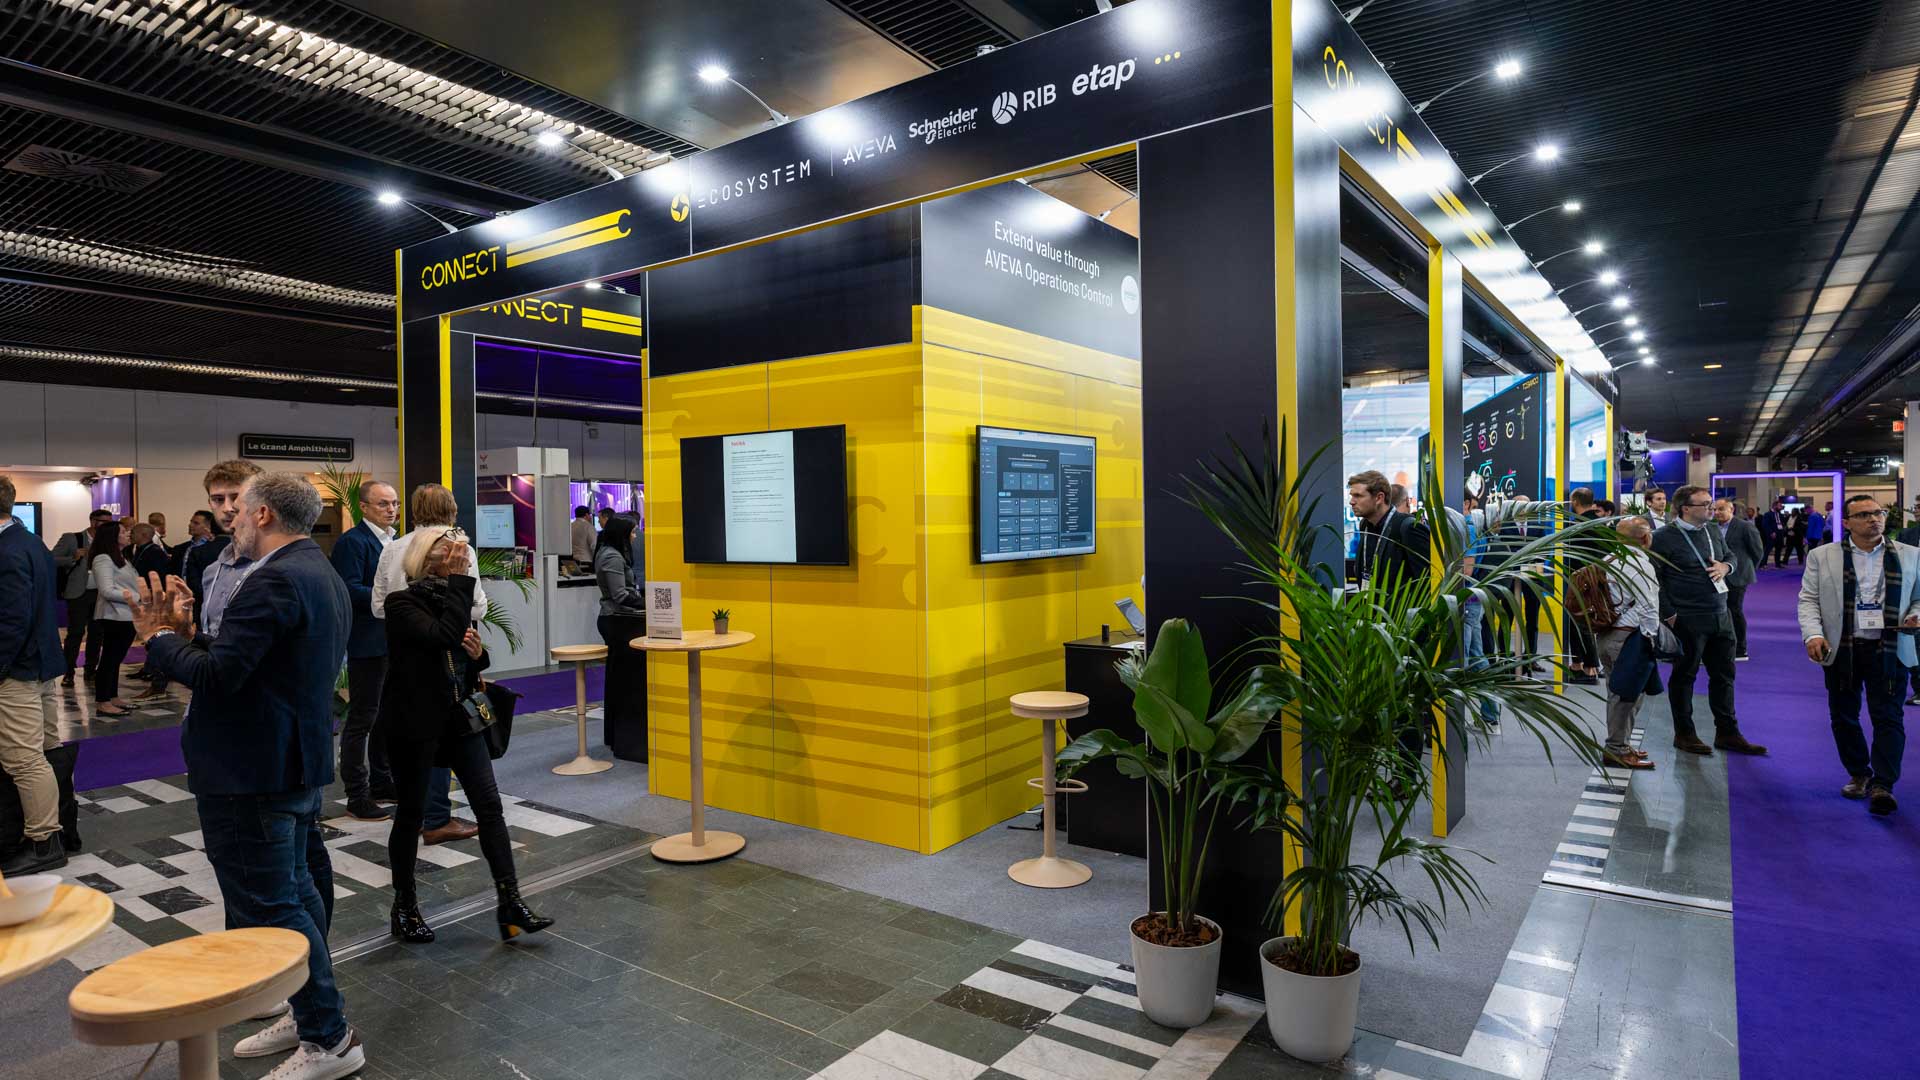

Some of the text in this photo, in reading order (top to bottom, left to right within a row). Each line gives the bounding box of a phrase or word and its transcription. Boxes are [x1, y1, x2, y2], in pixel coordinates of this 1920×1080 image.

[1071, 58, 1136, 96] etap
[1023, 83, 1057, 112] RIB
[908, 107, 978, 139] Schneider
[937, 120, 978, 140] Electric
[842, 134, 897, 166] AVEVA
[697, 159, 812, 209] ECOSYSTEM
[994, 220, 1100, 279] Extend value through
[421, 245, 501, 290] CONNECT
[985, 247, 1023, 278] AVEVA
[1025, 262, 1080, 297] Operations
[1081, 282, 1113, 309] Control
[479, 297, 575, 325] NNECT
[248, 442, 259, 450] Le
[260, 443, 287, 451] Grand
